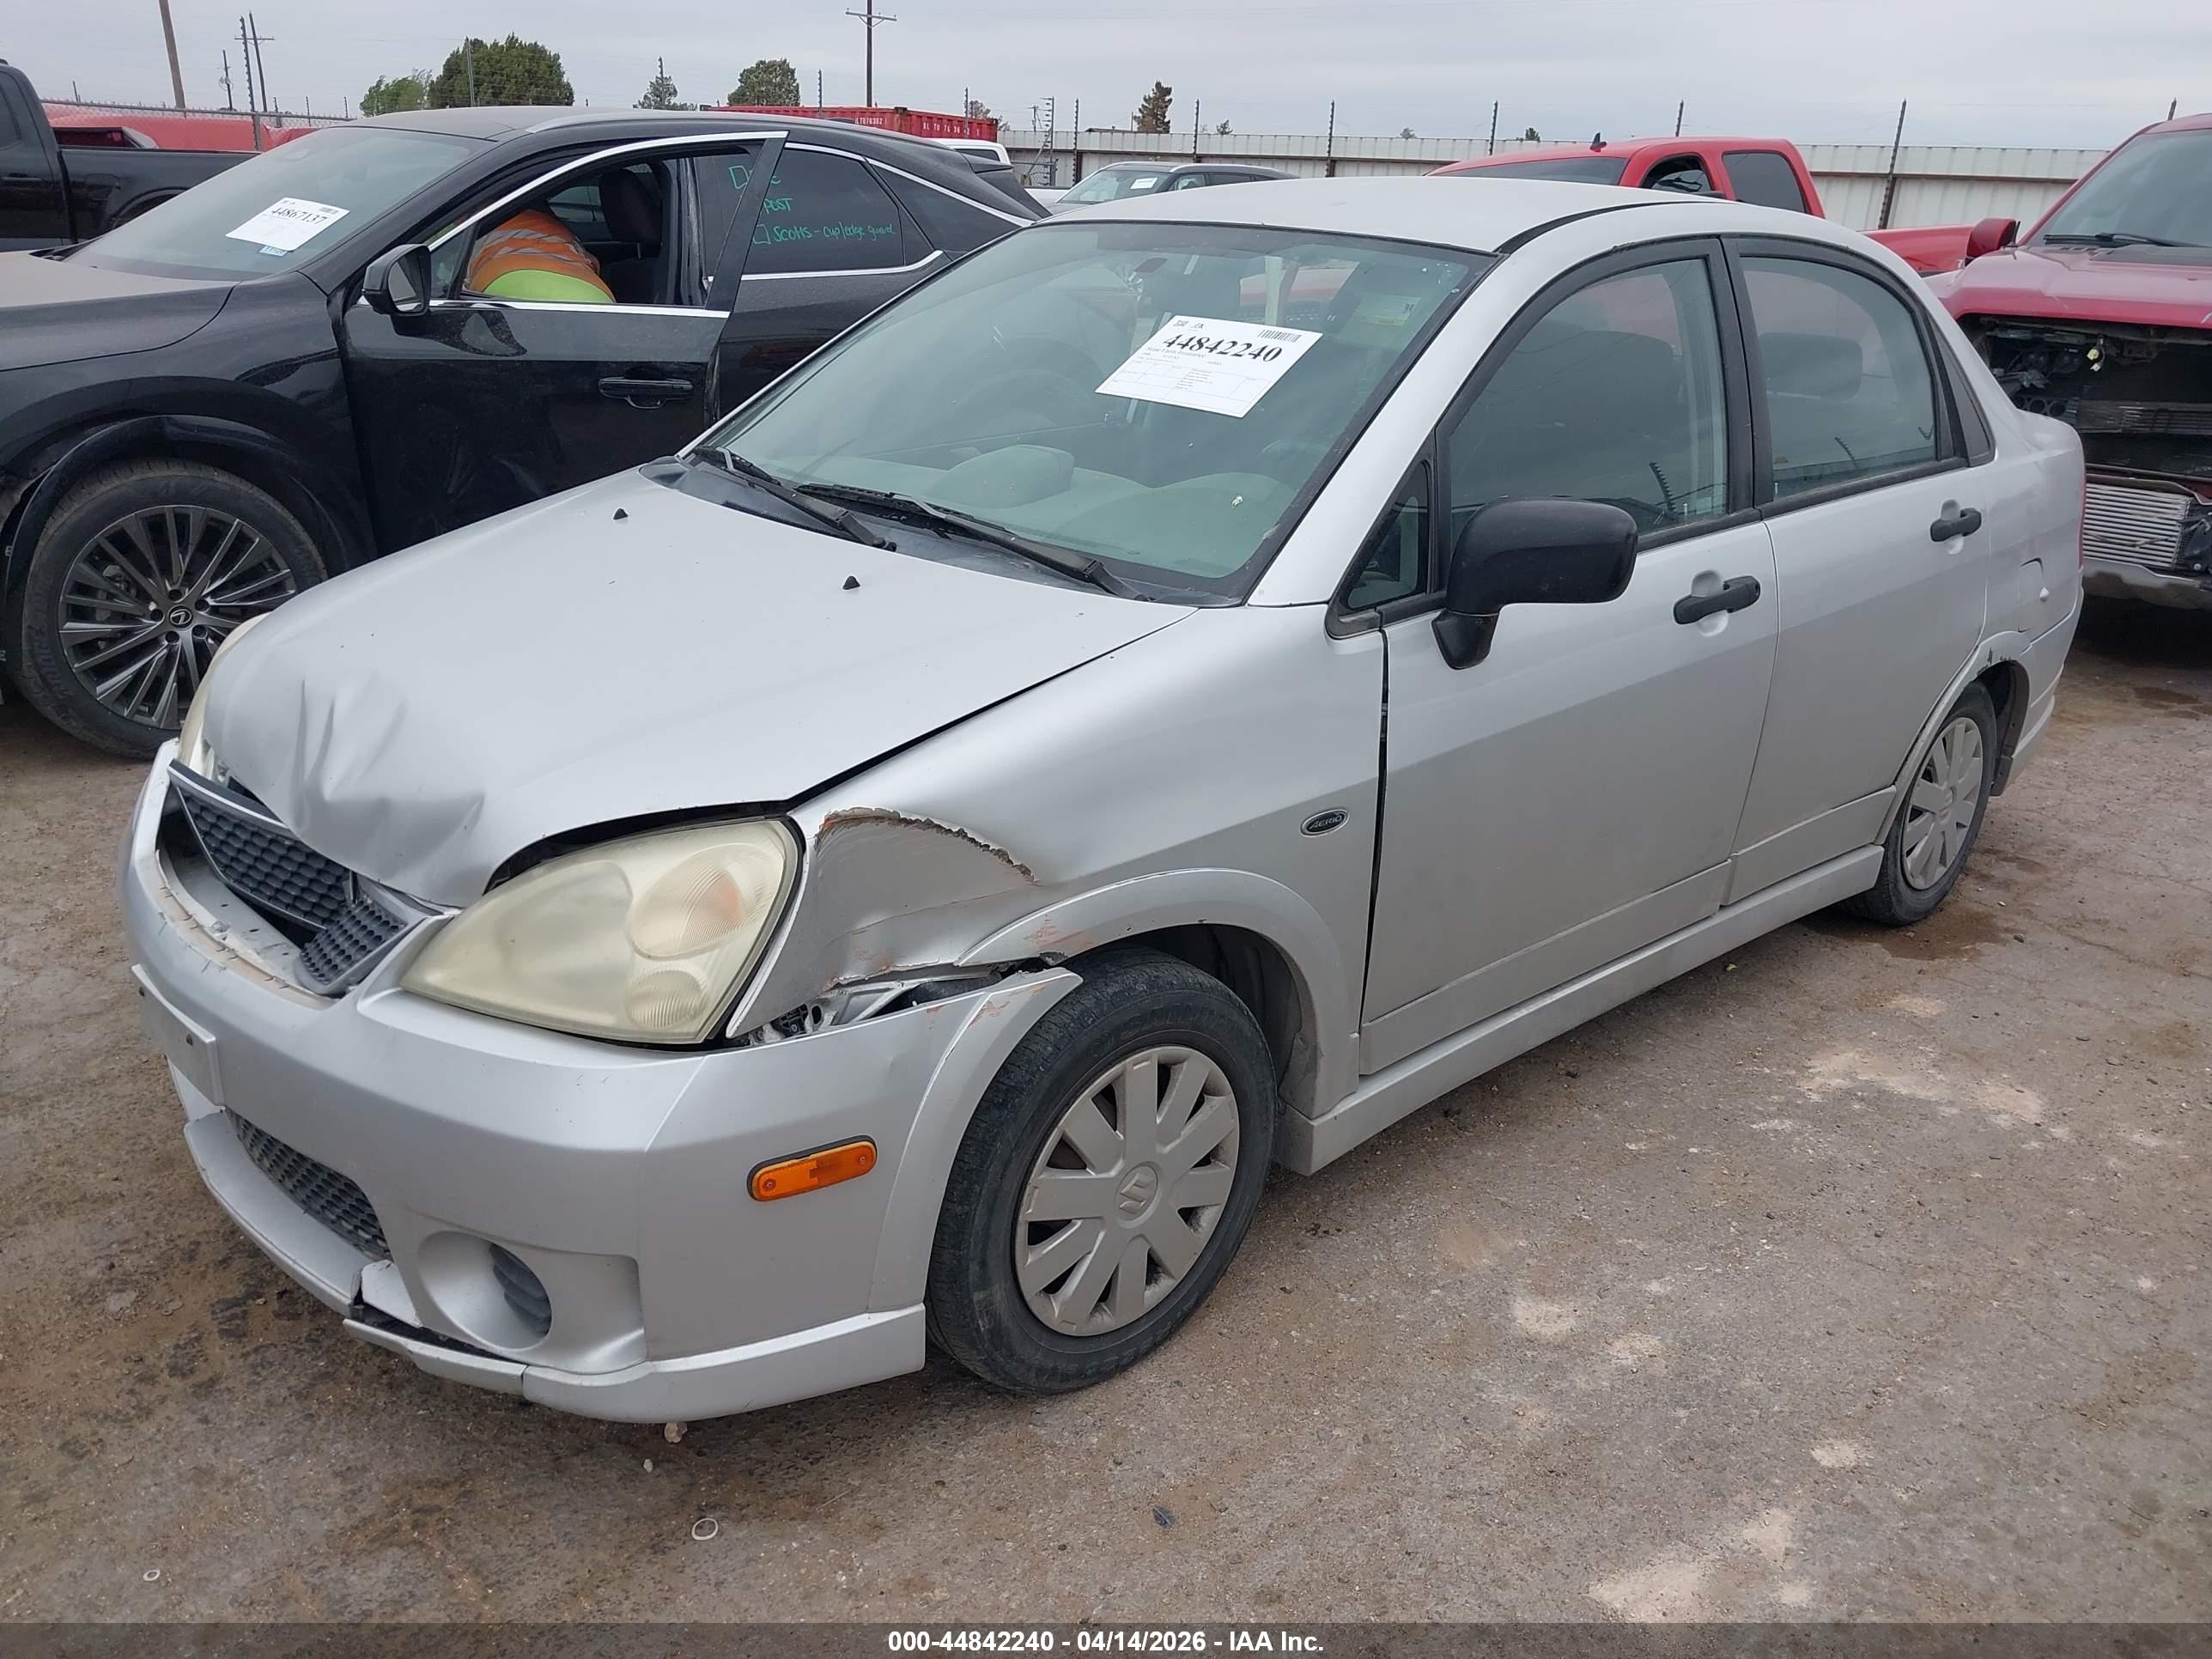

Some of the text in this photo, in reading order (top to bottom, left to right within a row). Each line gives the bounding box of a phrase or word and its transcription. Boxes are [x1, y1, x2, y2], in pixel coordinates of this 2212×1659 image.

[271, 207, 328, 225] 44867137
[1163, 334, 1283, 362] 44842240
[1309, 815, 1342, 830] AERIO
